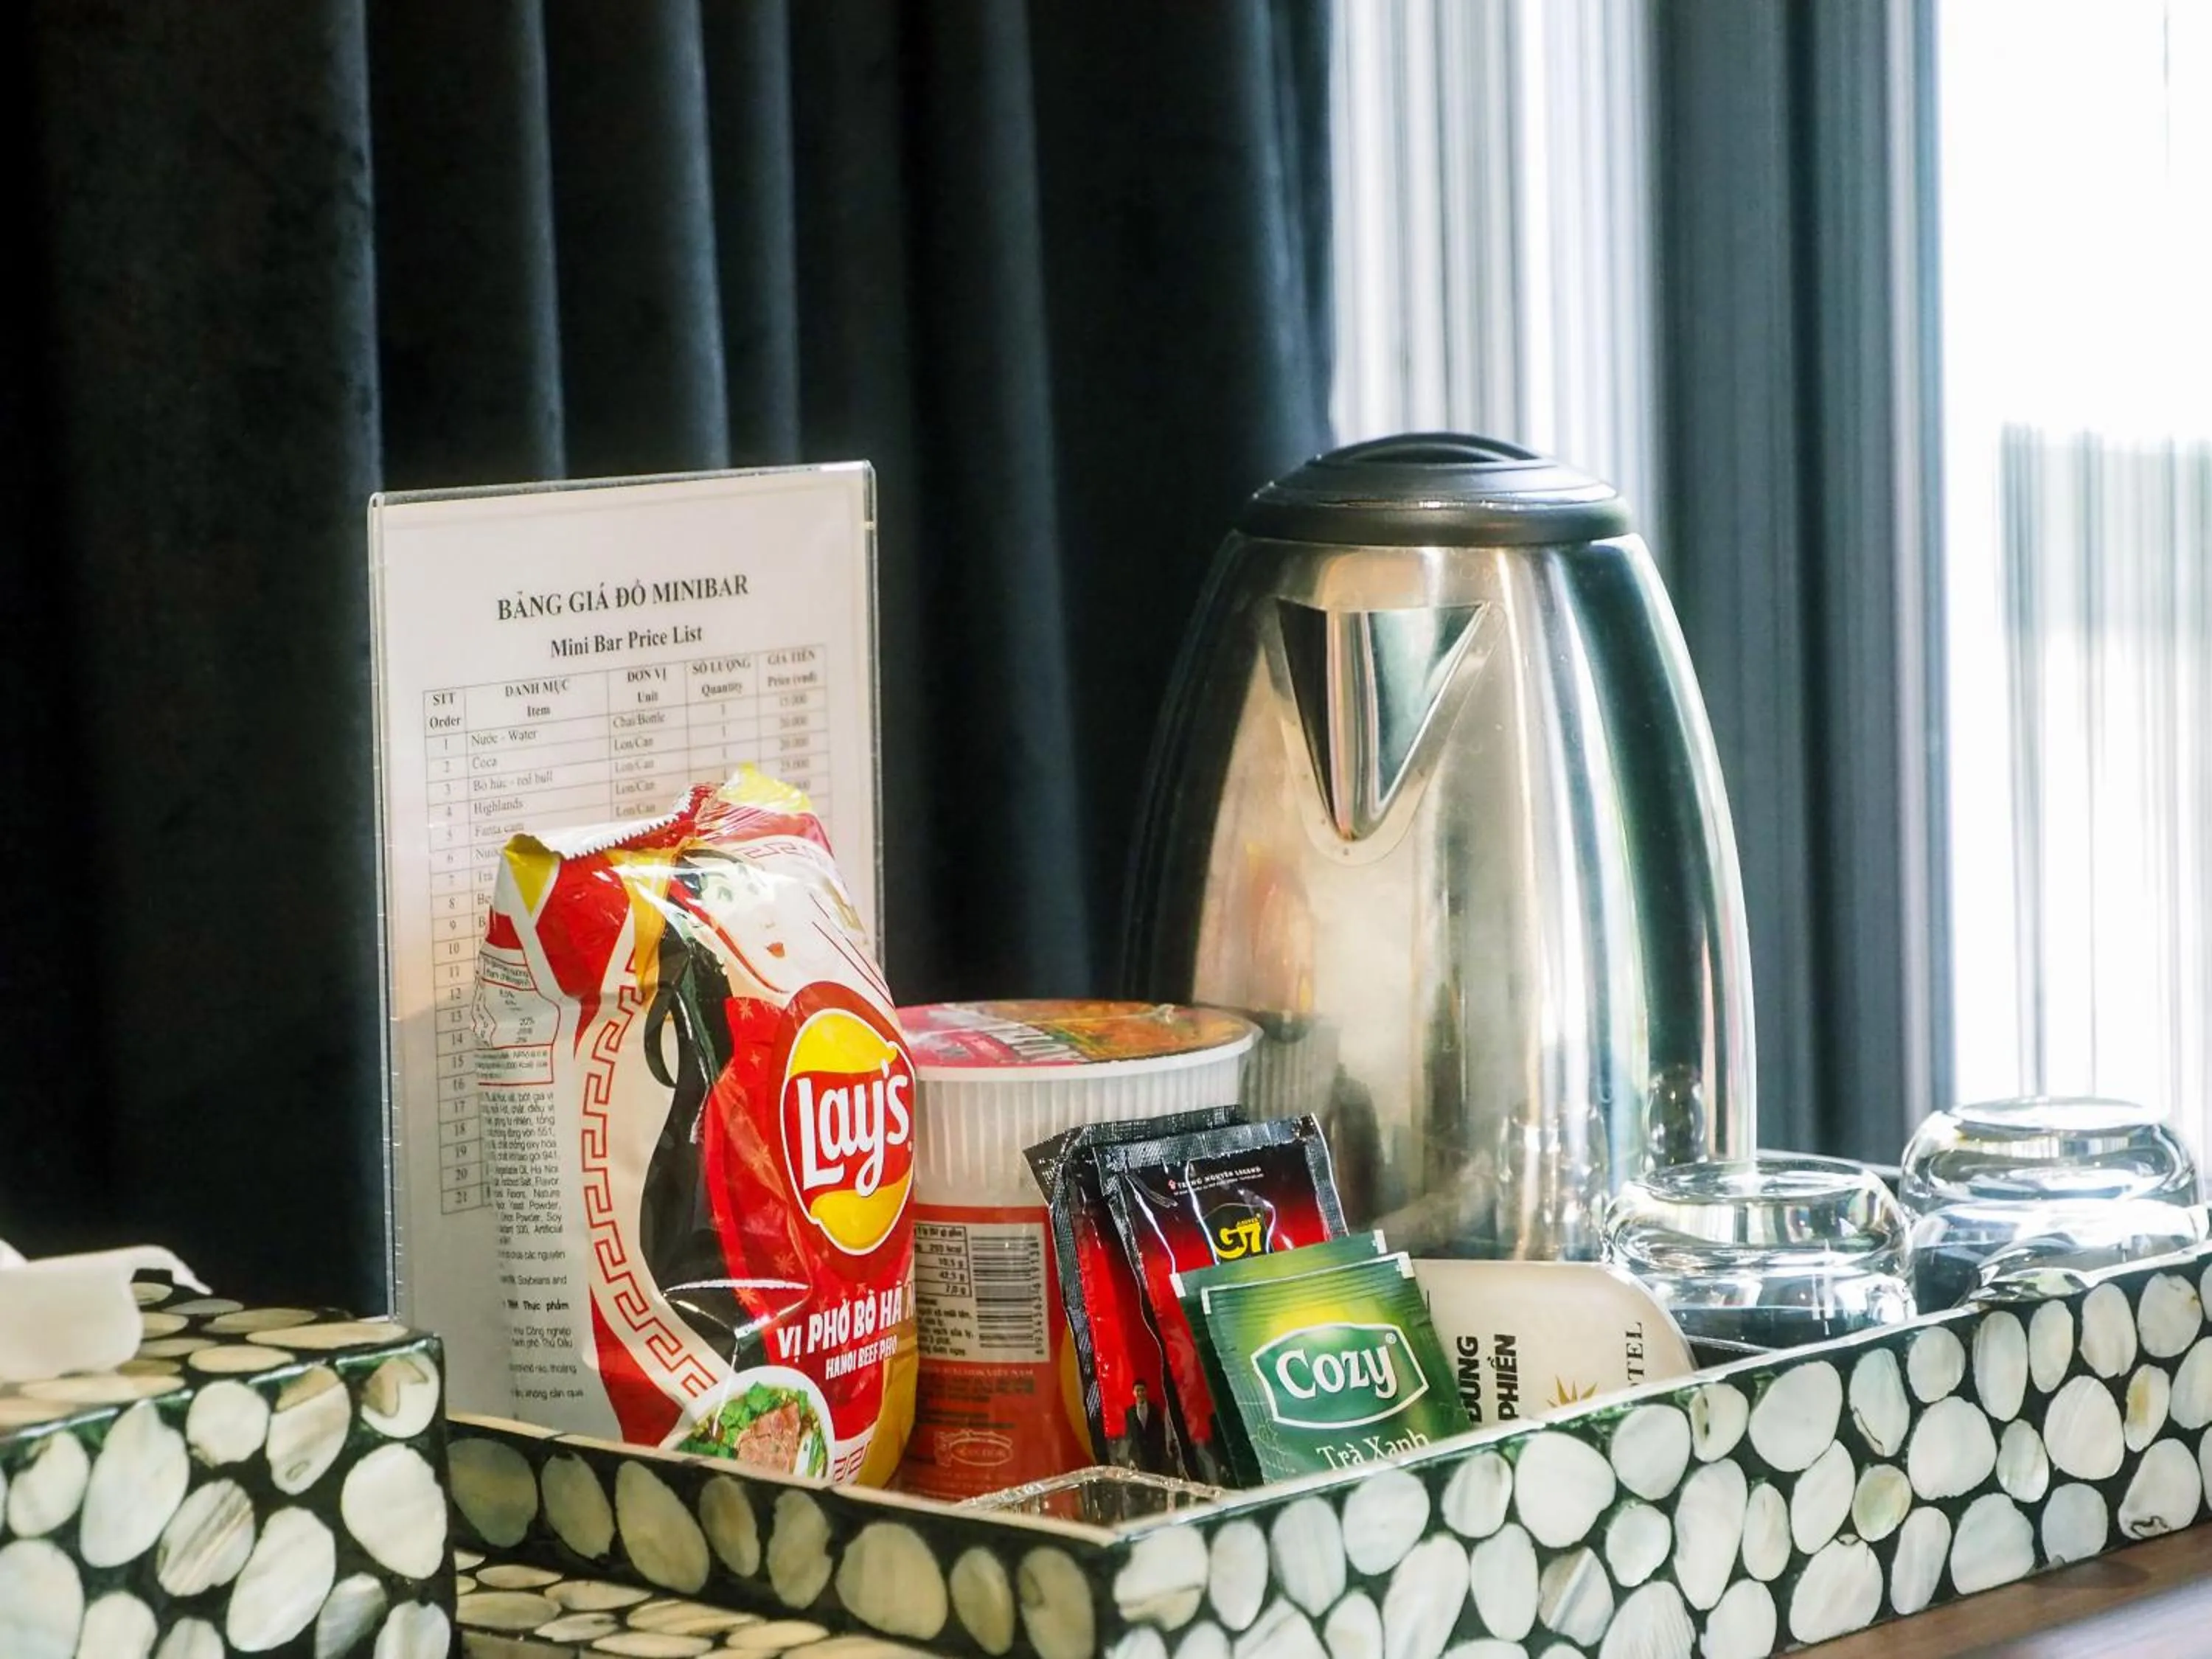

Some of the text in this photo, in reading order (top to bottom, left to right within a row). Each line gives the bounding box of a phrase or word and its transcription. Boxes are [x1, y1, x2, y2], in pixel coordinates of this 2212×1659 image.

[498, 591, 563, 621] BẢNG
[568, 582, 609, 613] GIÁ
[653, 574, 749, 604] MINIBAR
[551, 625, 703, 658] Mini Bar Price List
[701, 681, 743, 698] Quantity
[637, 690, 659, 703] Unit
[526, 705, 551, 718] Item
[429, 717, 462, 729] Order
[508, 729, 537, 742] Water
[448, 897, 457, 909] 8
[448, 943, 459, 955] 10
[450, 965, 460, 978] 11
[450, 988, 462, 1001] 12
[451, 1011, 462, 1023] 13
[452, 1034, 463, 1046] 14
[453, 1056, 465, 1068] 15
[453, 1079, 466, 1091] 16
[454, 1100, 466, 1113] 17
[796, 1058, 909, 1197] Lay's
[456, 1145, 467, 1158] 19
[455, 1168, 468, 1180] 20
[454, 1191, 467, 1203] 21
[776, 1325, 802, 1363] VỊ
[807, 1298, 850, 1354] PHỞ
[854, 1289, 877, 1340] BÒ
[826, 1349, 856, 1380] HANOI
[858, 1340, 879, 1368] BEEF
[1276, 1345, 1398, 1399] Cozy
[1316, 1427, 1430, 1471] Trà Xanh
